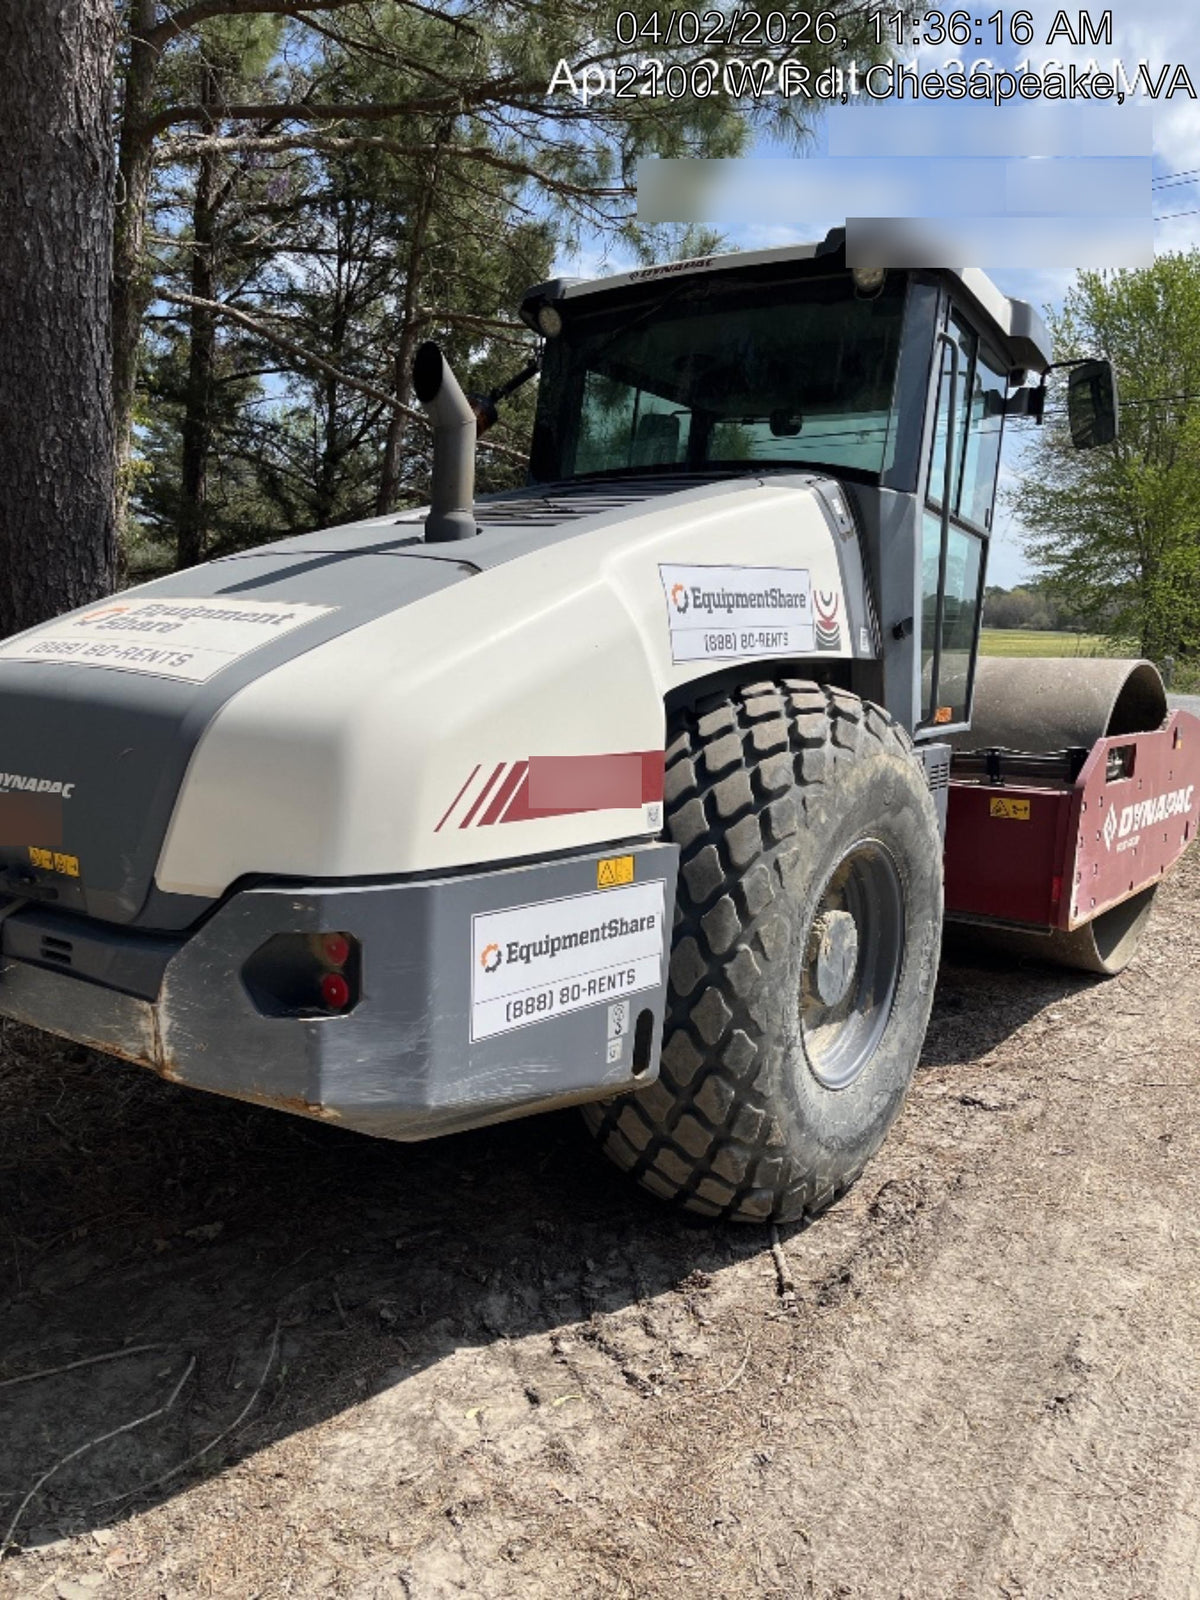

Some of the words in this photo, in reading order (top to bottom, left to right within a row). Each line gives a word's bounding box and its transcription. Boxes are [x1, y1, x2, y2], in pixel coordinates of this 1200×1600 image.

[690, 586, 807, 614] EquipmentShare
[96, 615, 183, 634] Share
[127, 603, 297, 625] Equipment
[703, 632, 737, 652] (888)
[80, 644, 195, 668] 80-RENTS
[1118, 784, 1194, 838] DYNAPAC
[506, 914, 656, 964] EquipmentShare
[506, 990, 554, 1022] (888)
[559, 968, 636, 1005] 80-RENTS
